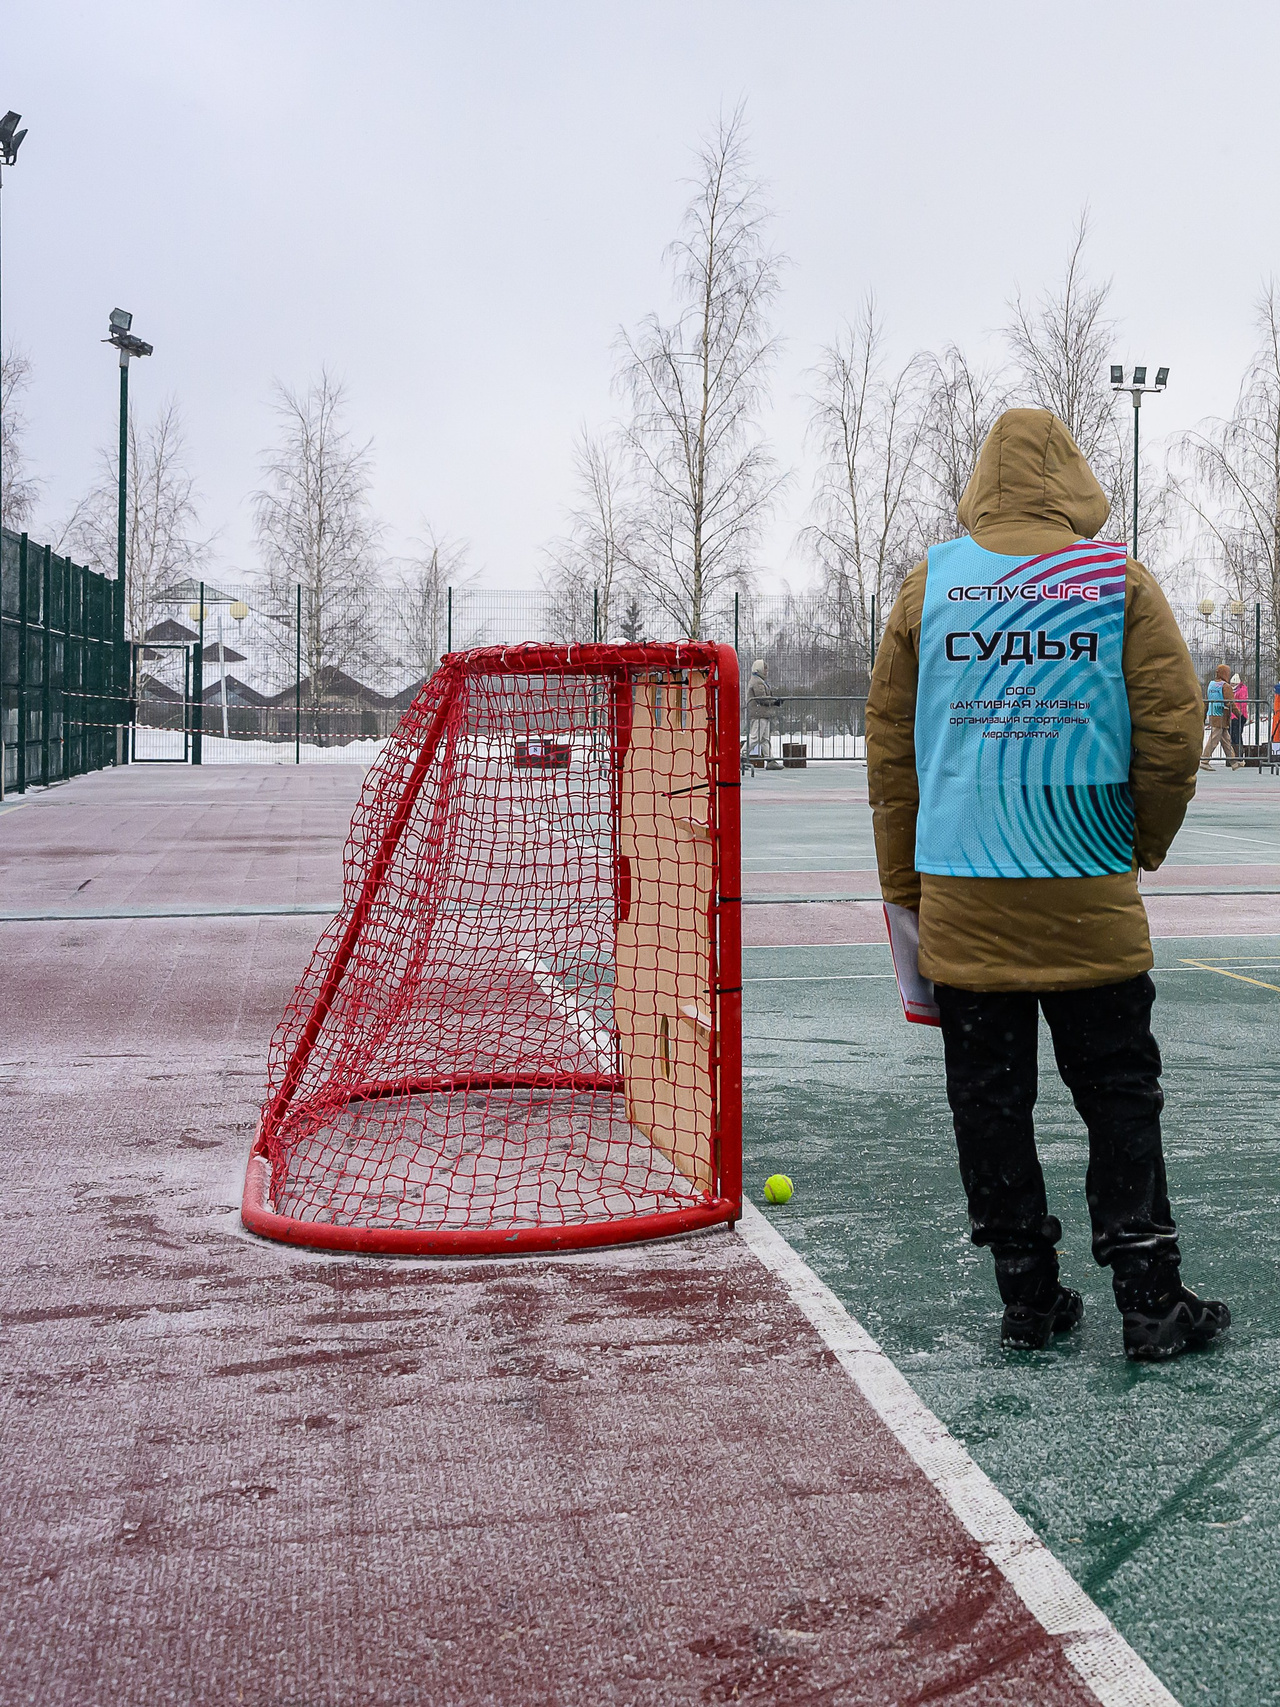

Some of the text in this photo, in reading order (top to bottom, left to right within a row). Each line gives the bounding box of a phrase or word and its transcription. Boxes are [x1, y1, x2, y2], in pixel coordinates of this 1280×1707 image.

[945, 630, 1099, 666] СУДЬЯ
[1005, 686, 1036, 696] ООО
[949, 699, 1090, 710] «АКТИВНАЯ ЖИЗНЬ»
[949, 716, 1020, 727] организация
[982, 730, 1060, 741] мероприятий
